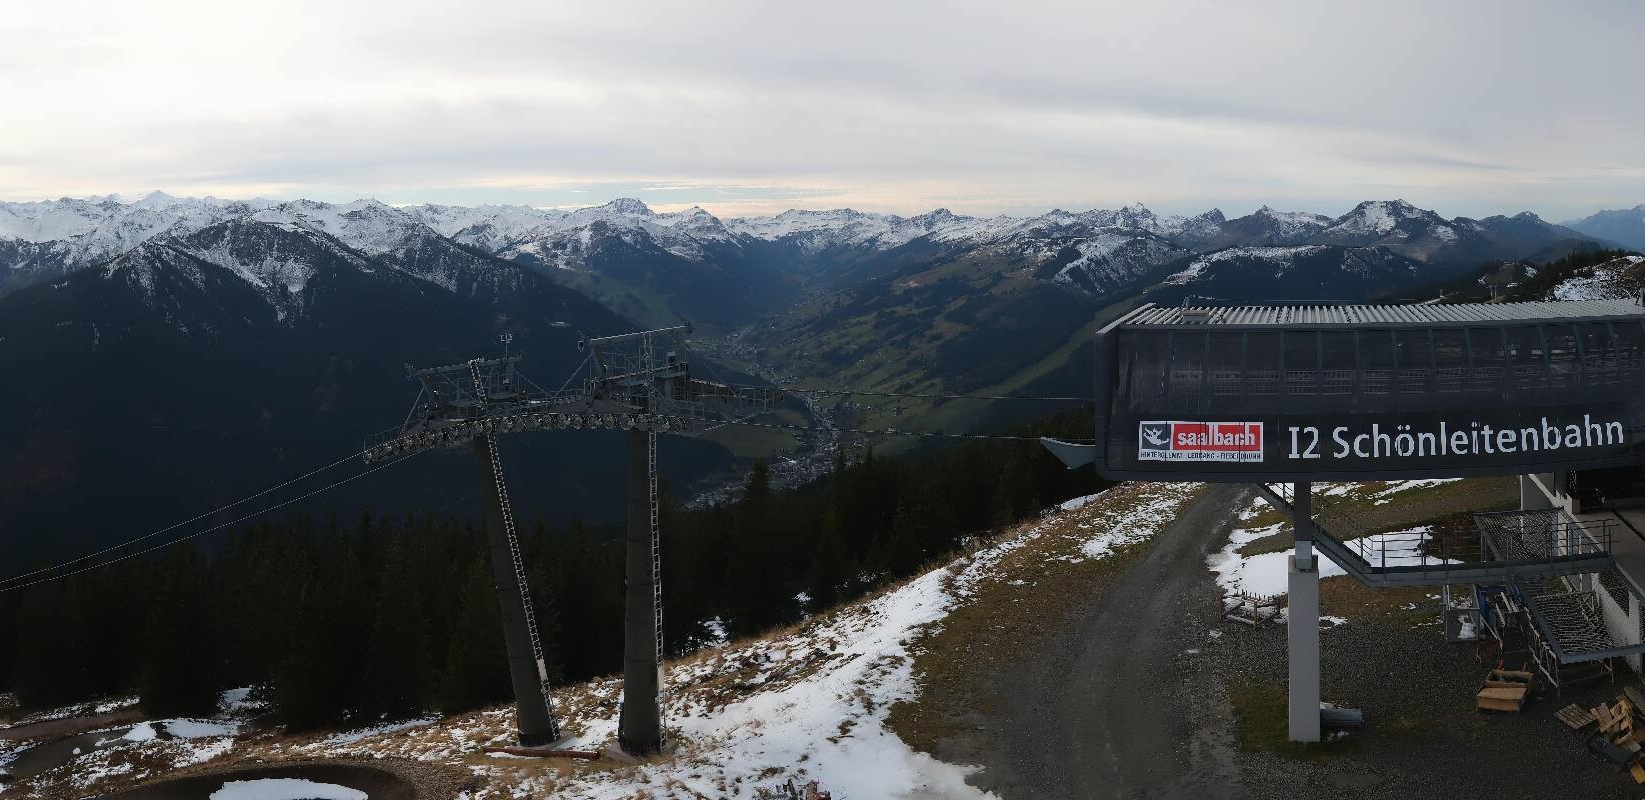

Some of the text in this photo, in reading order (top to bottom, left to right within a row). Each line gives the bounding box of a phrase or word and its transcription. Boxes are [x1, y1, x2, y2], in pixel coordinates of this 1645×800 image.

[1177, 422, 1255, 446] saalbach
[1288, 414, 1624, 459] I2 Schönleitenbahn
